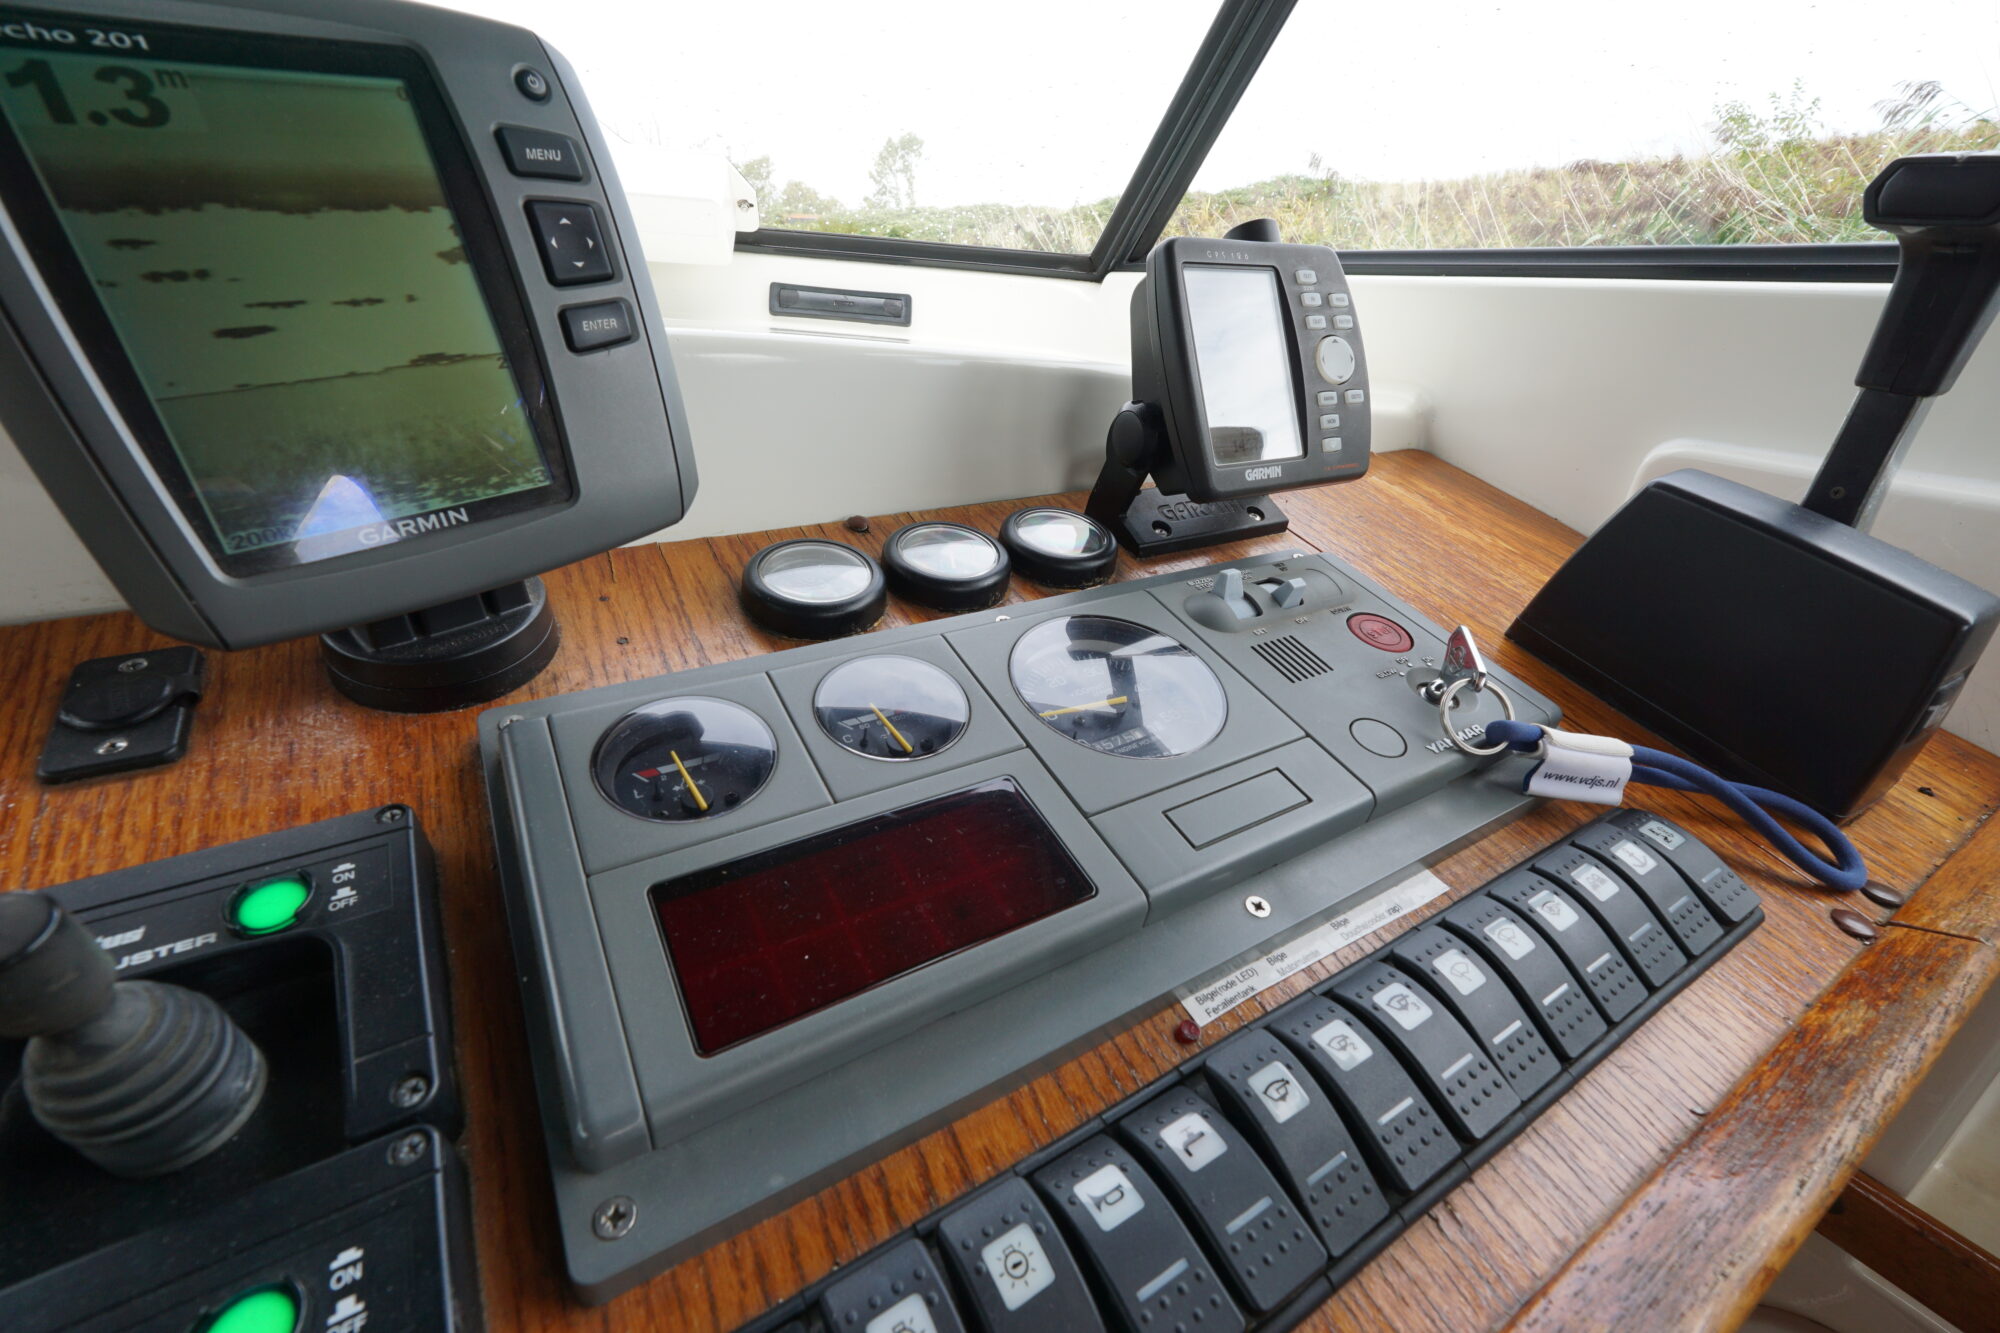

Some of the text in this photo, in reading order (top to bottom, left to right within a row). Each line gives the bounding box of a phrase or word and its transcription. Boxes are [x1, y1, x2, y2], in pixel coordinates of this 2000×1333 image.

[0, 22, 149, 50] cho 201
[5, 58, 171, 128] 1.3
[525, 148, 562, 162] MENU
[582, 318, 618, 332] ENTER
[1244, 465, 1282, 481] GARMIN
[357, 507, 470, 545] GARMIN
[1543, 770, 1621, 789] www.vdjs.nl
[332, 871, 356, 884] ON
[328, 896, 359, 912] OFF
[112, 932, 218, 971] USTER
[1266, 951, 1288, 967] Bilge
[1194, 967, 1260, 1006] Bilge(rode LED)
[1205, 984, 1257, 1018] Fecalientank
[329, 1261, 364, 1291] ON
